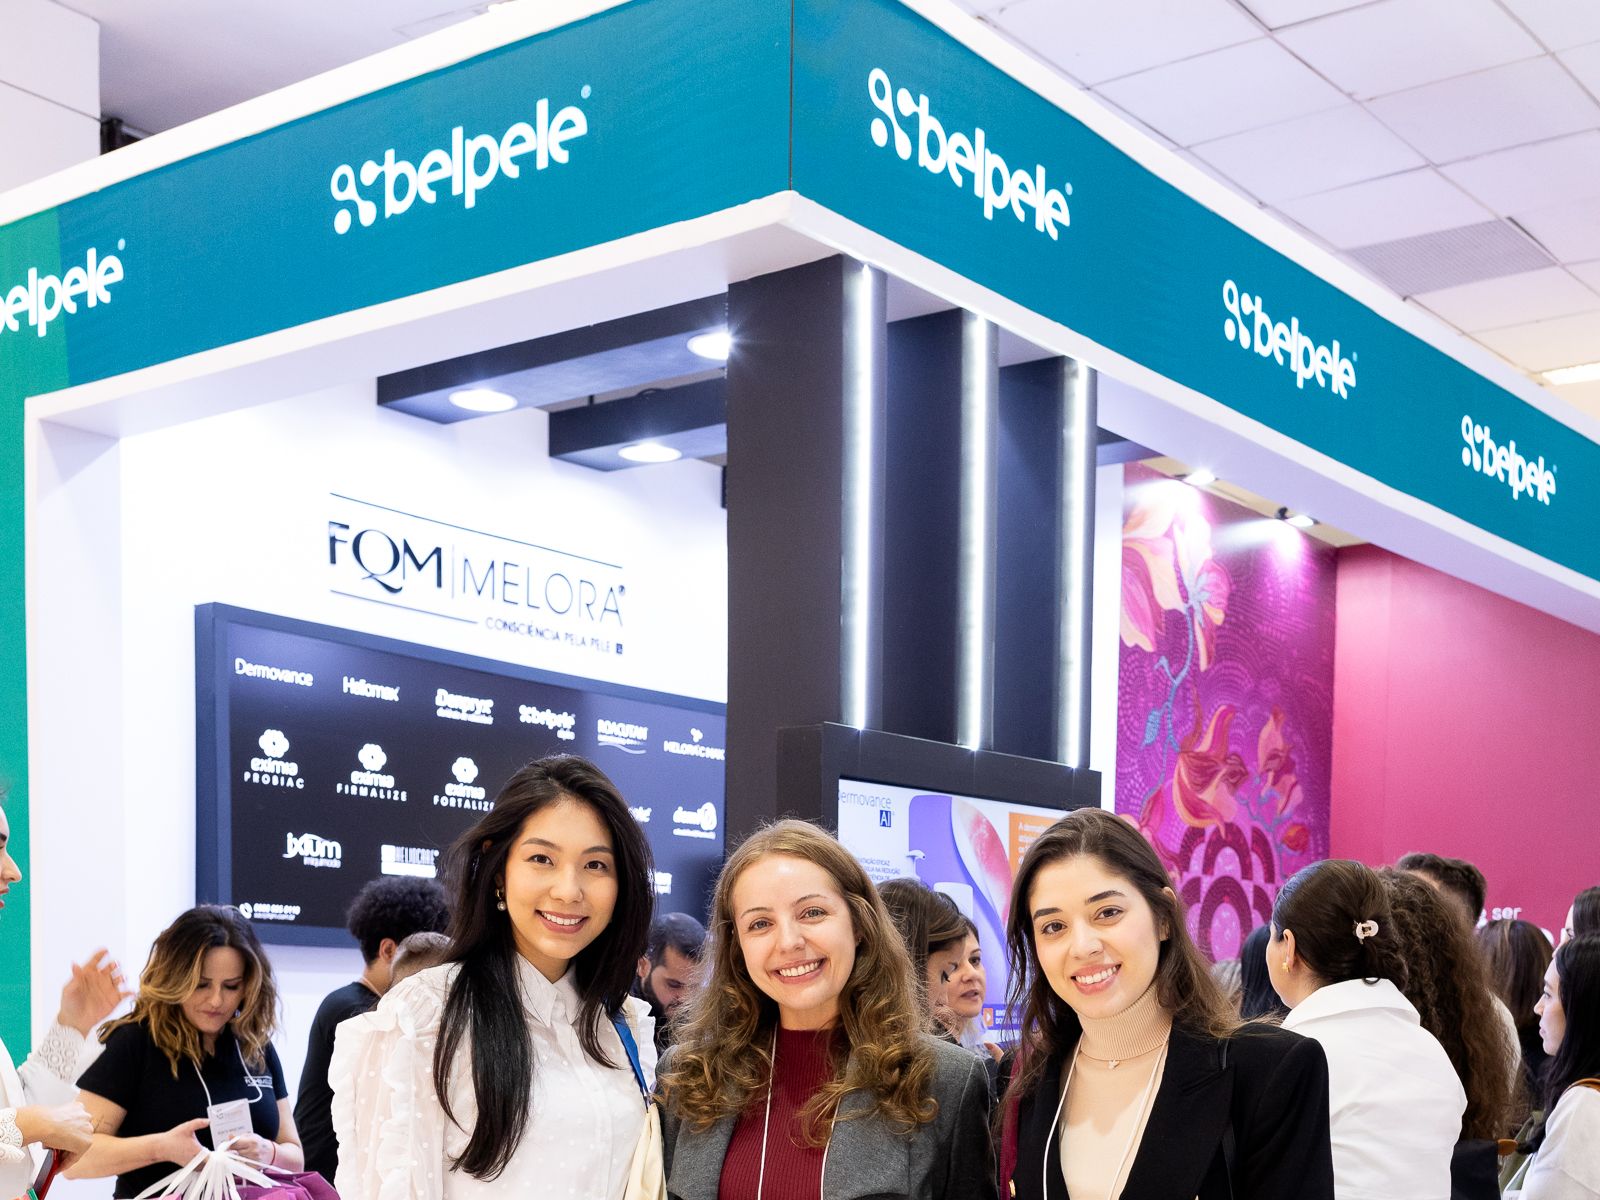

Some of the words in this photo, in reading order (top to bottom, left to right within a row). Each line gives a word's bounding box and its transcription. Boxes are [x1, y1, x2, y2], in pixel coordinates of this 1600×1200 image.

[376, 98, 588, 218] belpele
[896, 94, 1070, 241] belpele
[1250, 296, 1356, 399] belpele
[1479, 428, 1556, 505] belpele
[328, 520, 443, 594] FQM
[463, 557, 623, 627] MELORA
[234, 657, 314, 687] Dermovance
[243, 770, 305, 789] PROBIAC
[336, 782, 407, 802] FIRMALIZE
[838, 790, 893, 810] ermovance
[1491, 906, 1522, 921] ser
